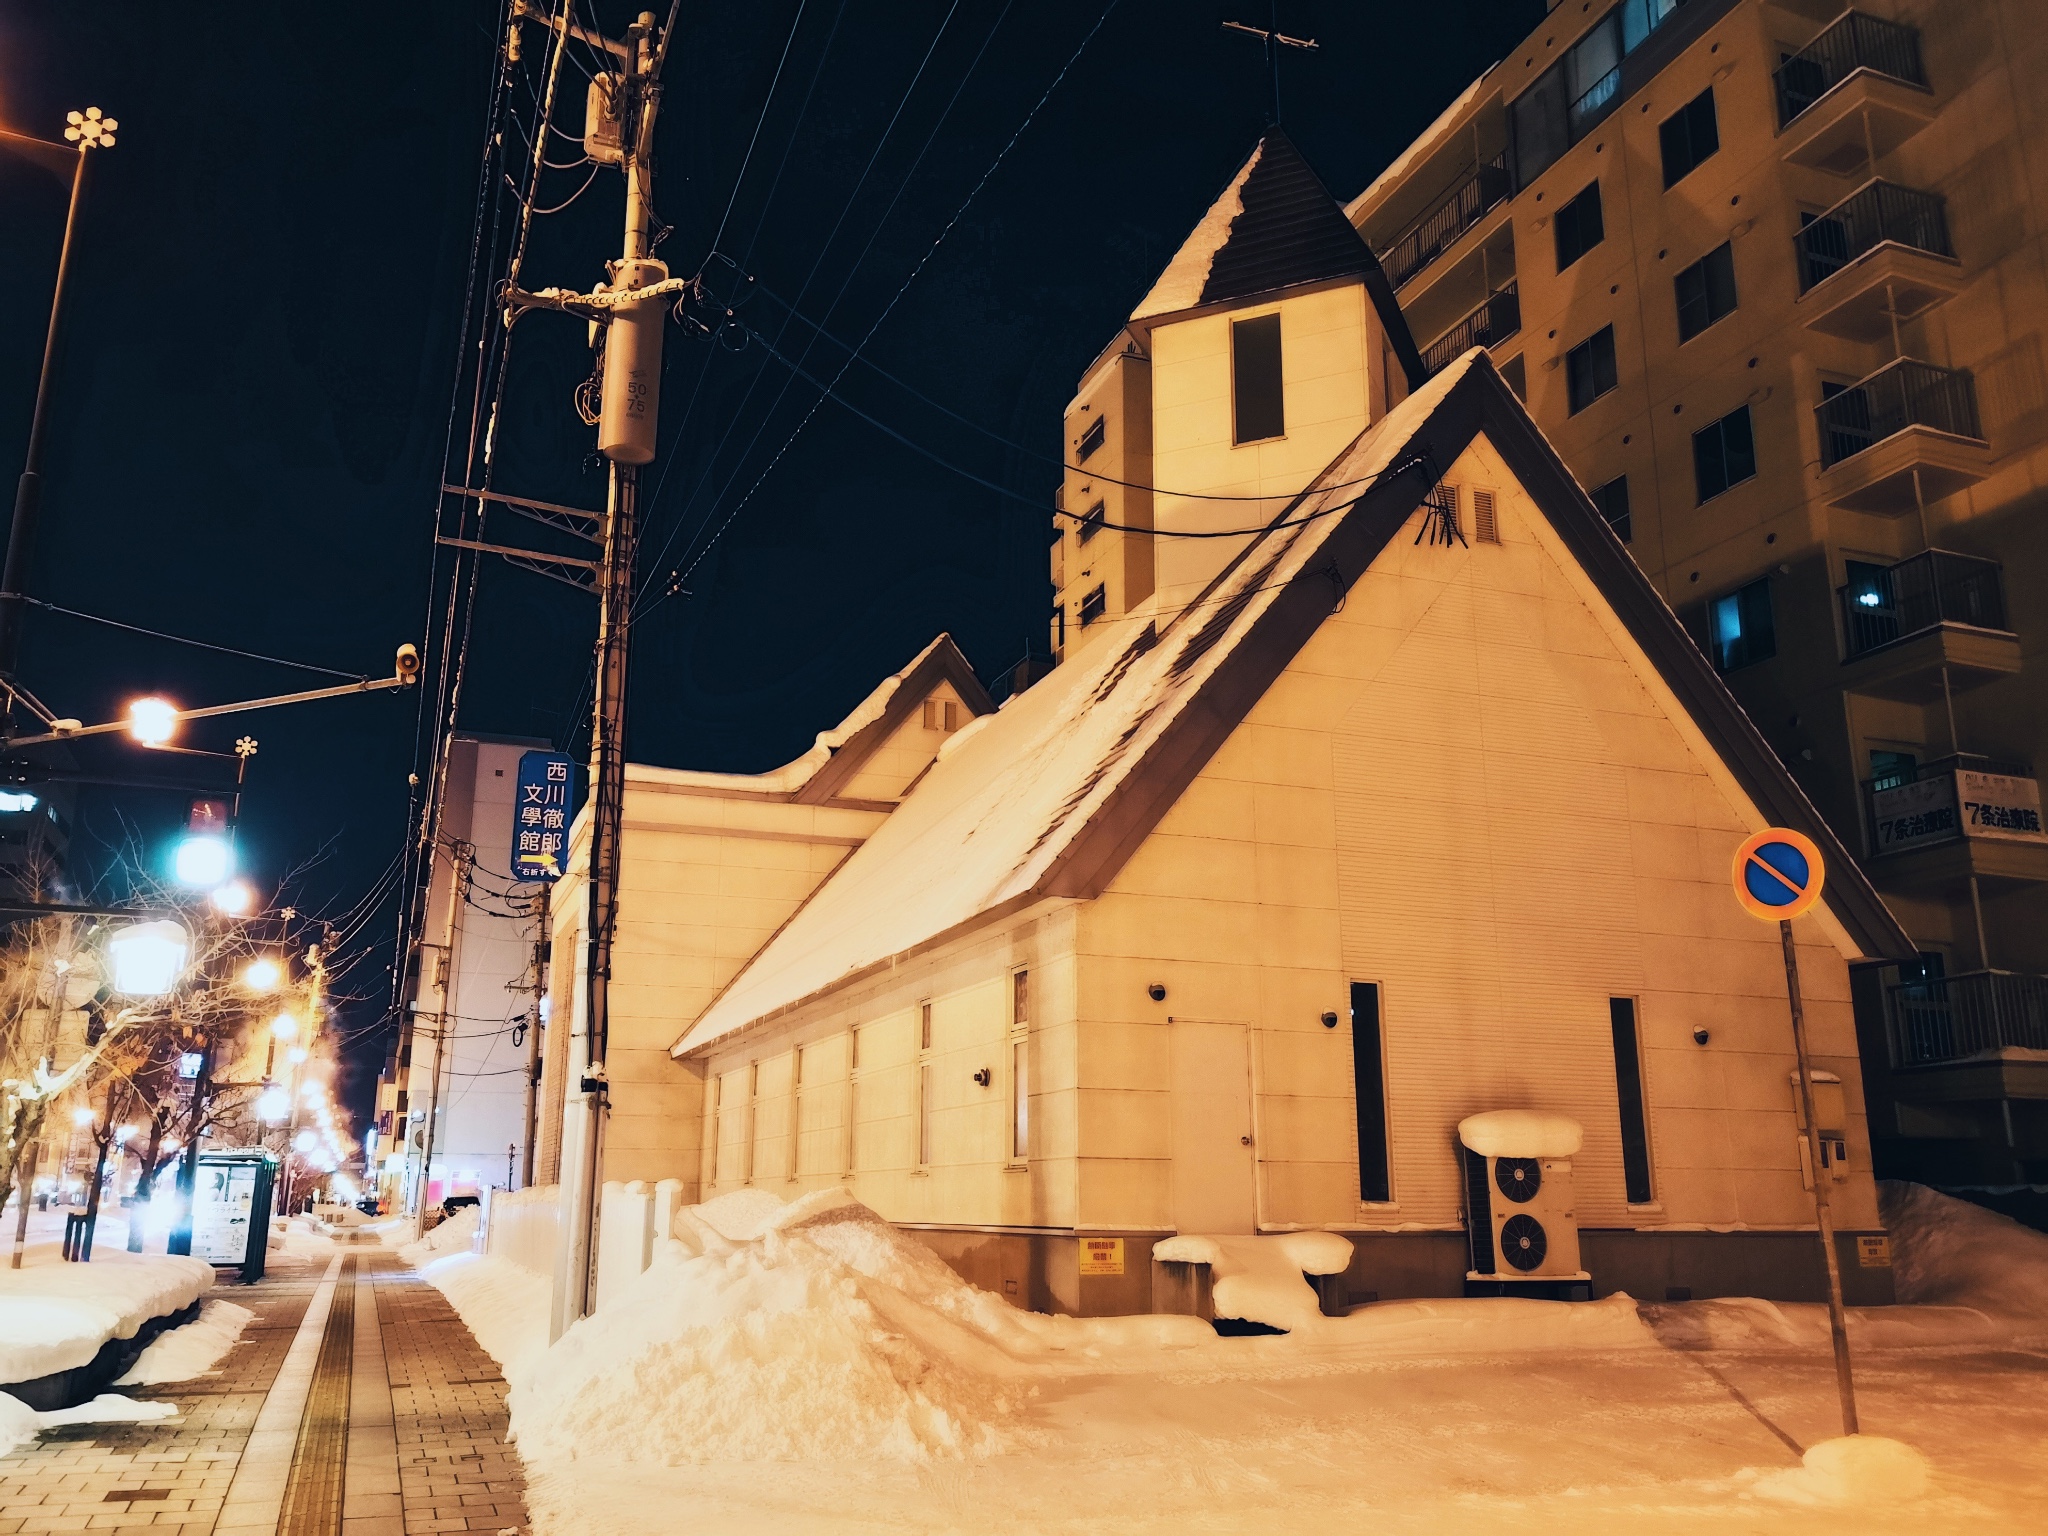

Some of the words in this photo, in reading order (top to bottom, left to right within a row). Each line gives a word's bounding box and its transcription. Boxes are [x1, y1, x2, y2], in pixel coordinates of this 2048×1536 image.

[627, 399, 646, 412] 75
[628, 382, 647, 395] 50
[519, 783, 544, 852] 文學館
[540, 761, 568, 853] 西川徹郎
